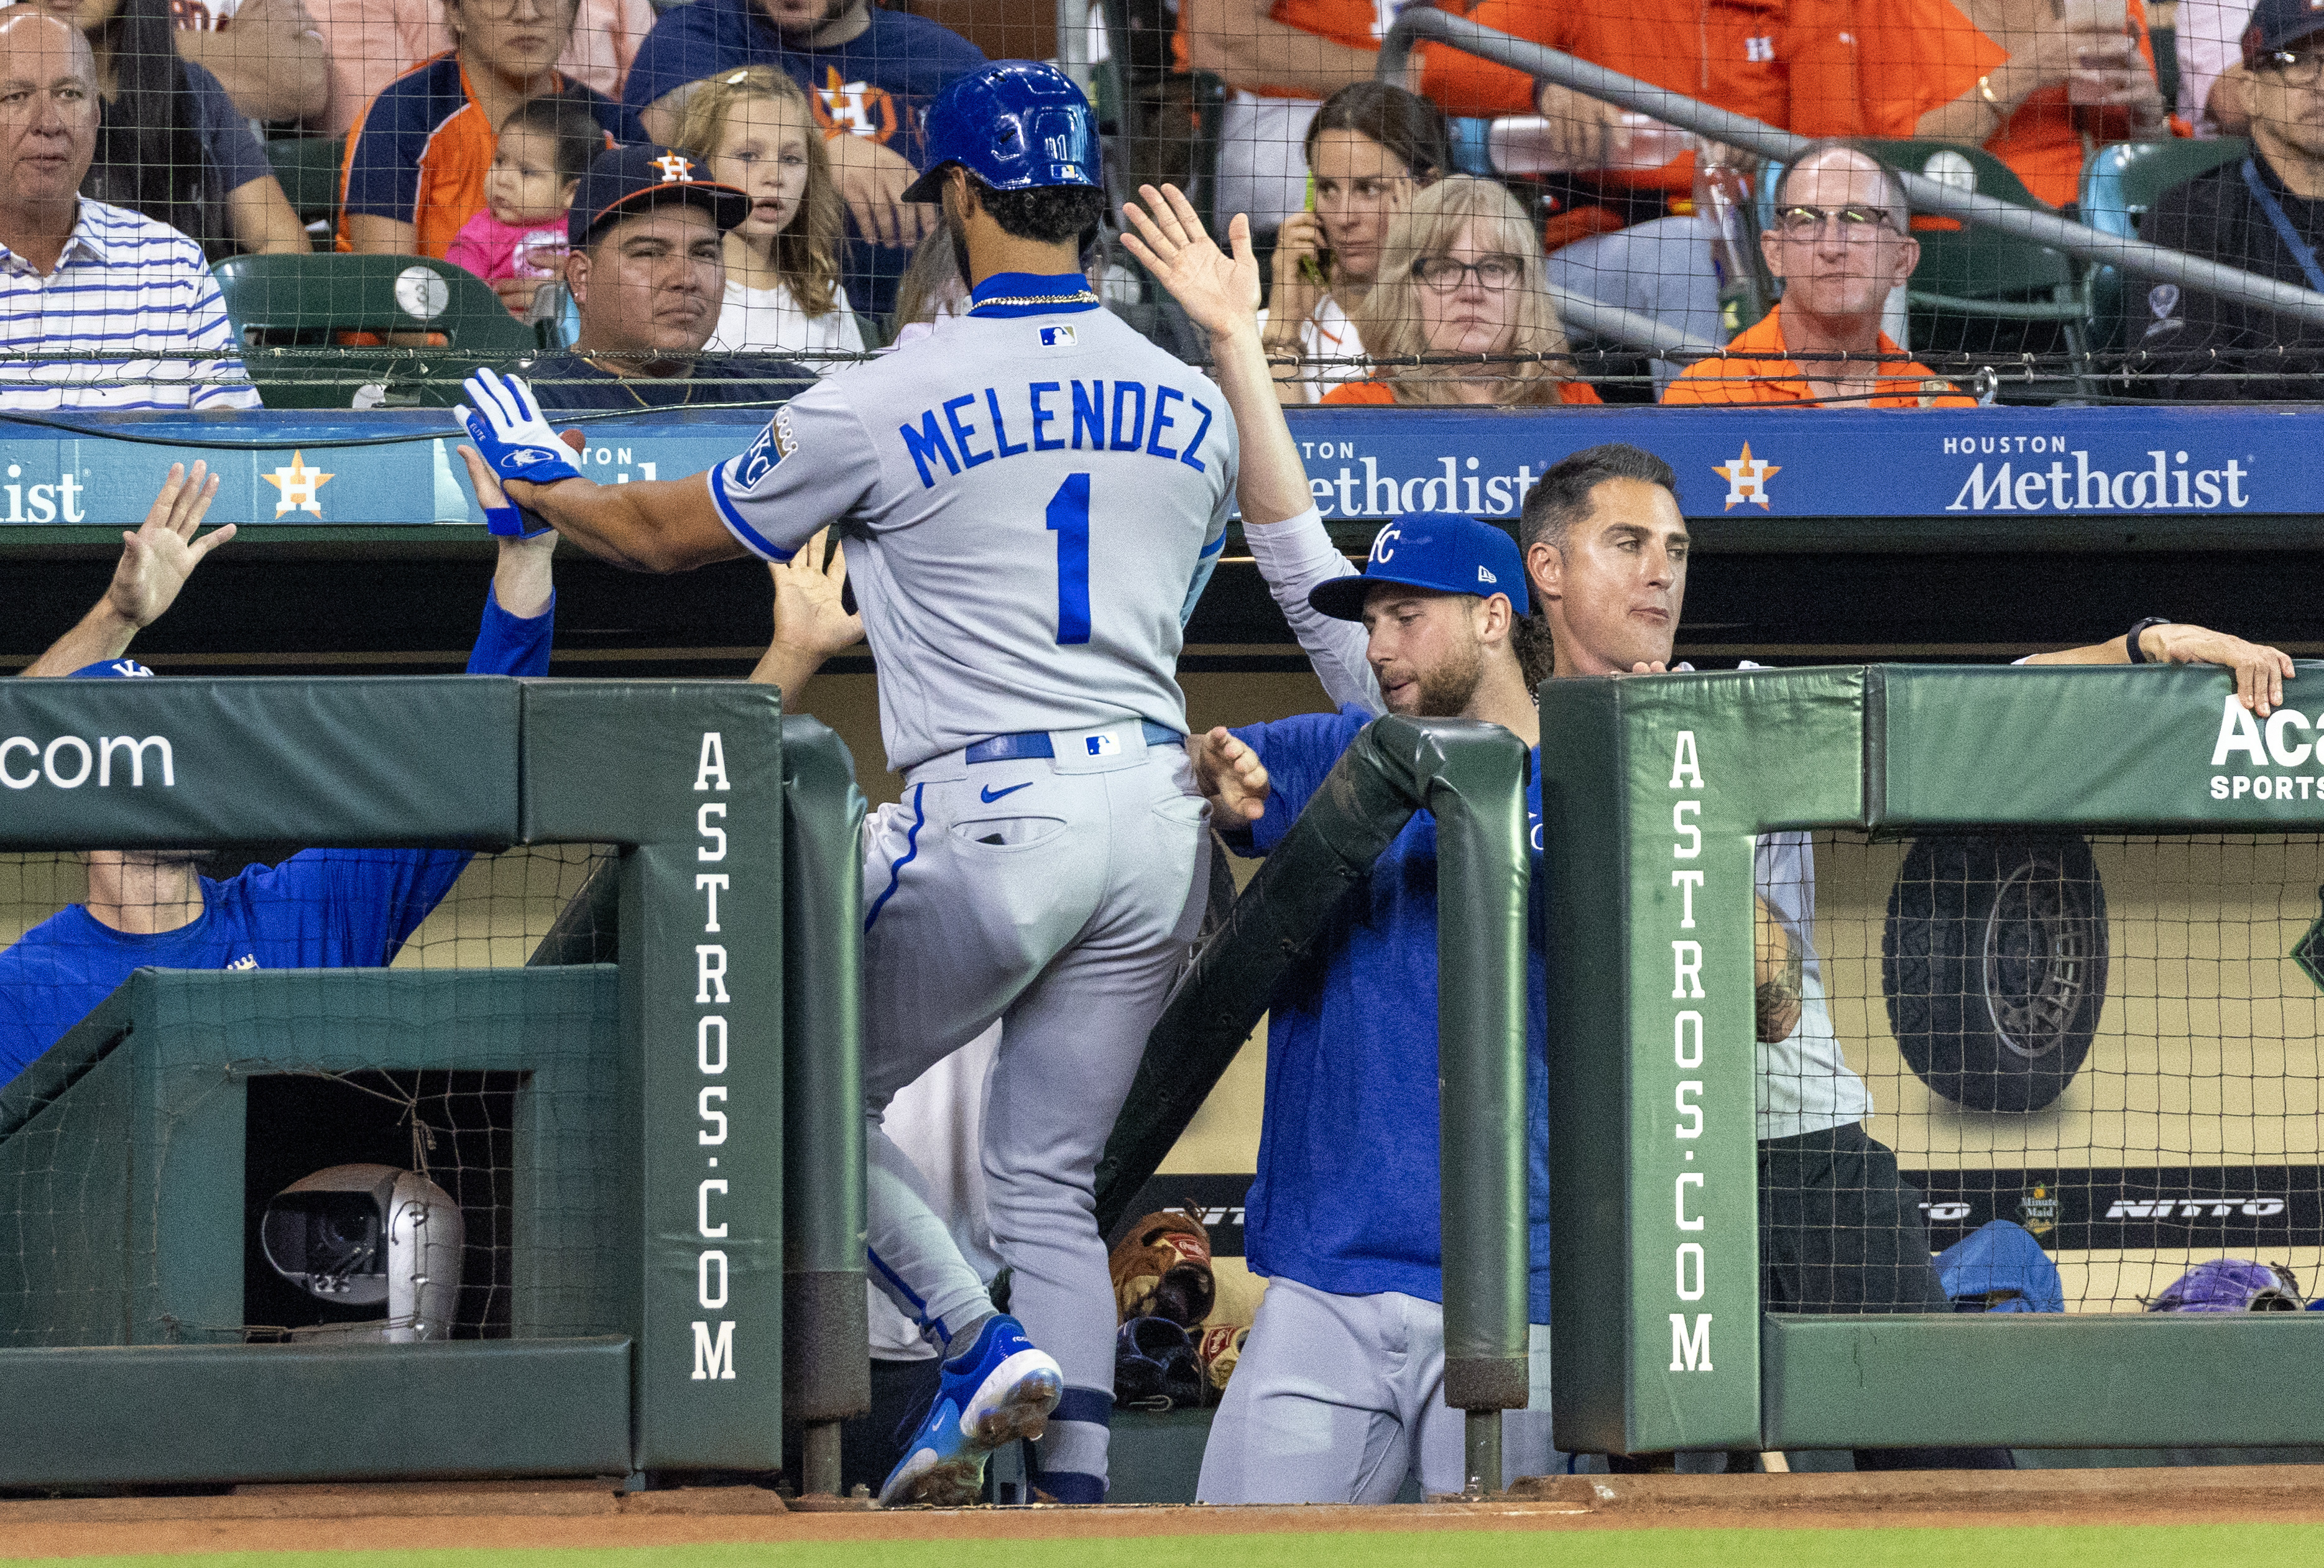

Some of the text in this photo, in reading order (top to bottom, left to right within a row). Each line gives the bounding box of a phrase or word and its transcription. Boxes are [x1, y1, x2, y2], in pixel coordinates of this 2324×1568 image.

[469, 422, 487, 442] ELITE
[899, 379, 1212, 489] MELENDEZ
[1302, 442, 1353, 459] TON
[1944, 436, 2065, 454] HOUSTON
[746, 429, 771, 484] KC
[0, 464, 85, 523] ist
[275, 466, 322, 511] H
[1725, 459, 1769, 503] H
[1945, 450, 2249, 510] Methodist
[1046, 473, 1091, 645] 1
[1368, 523, 1401, 563] KC
[2211, 693, 2324, 767] Ac
[2022, 1197, 2057, 1207] Minute
[2027, 1207, 2054, 1217] Maid
[2106, 1198, 2285, 1217] NITTO
